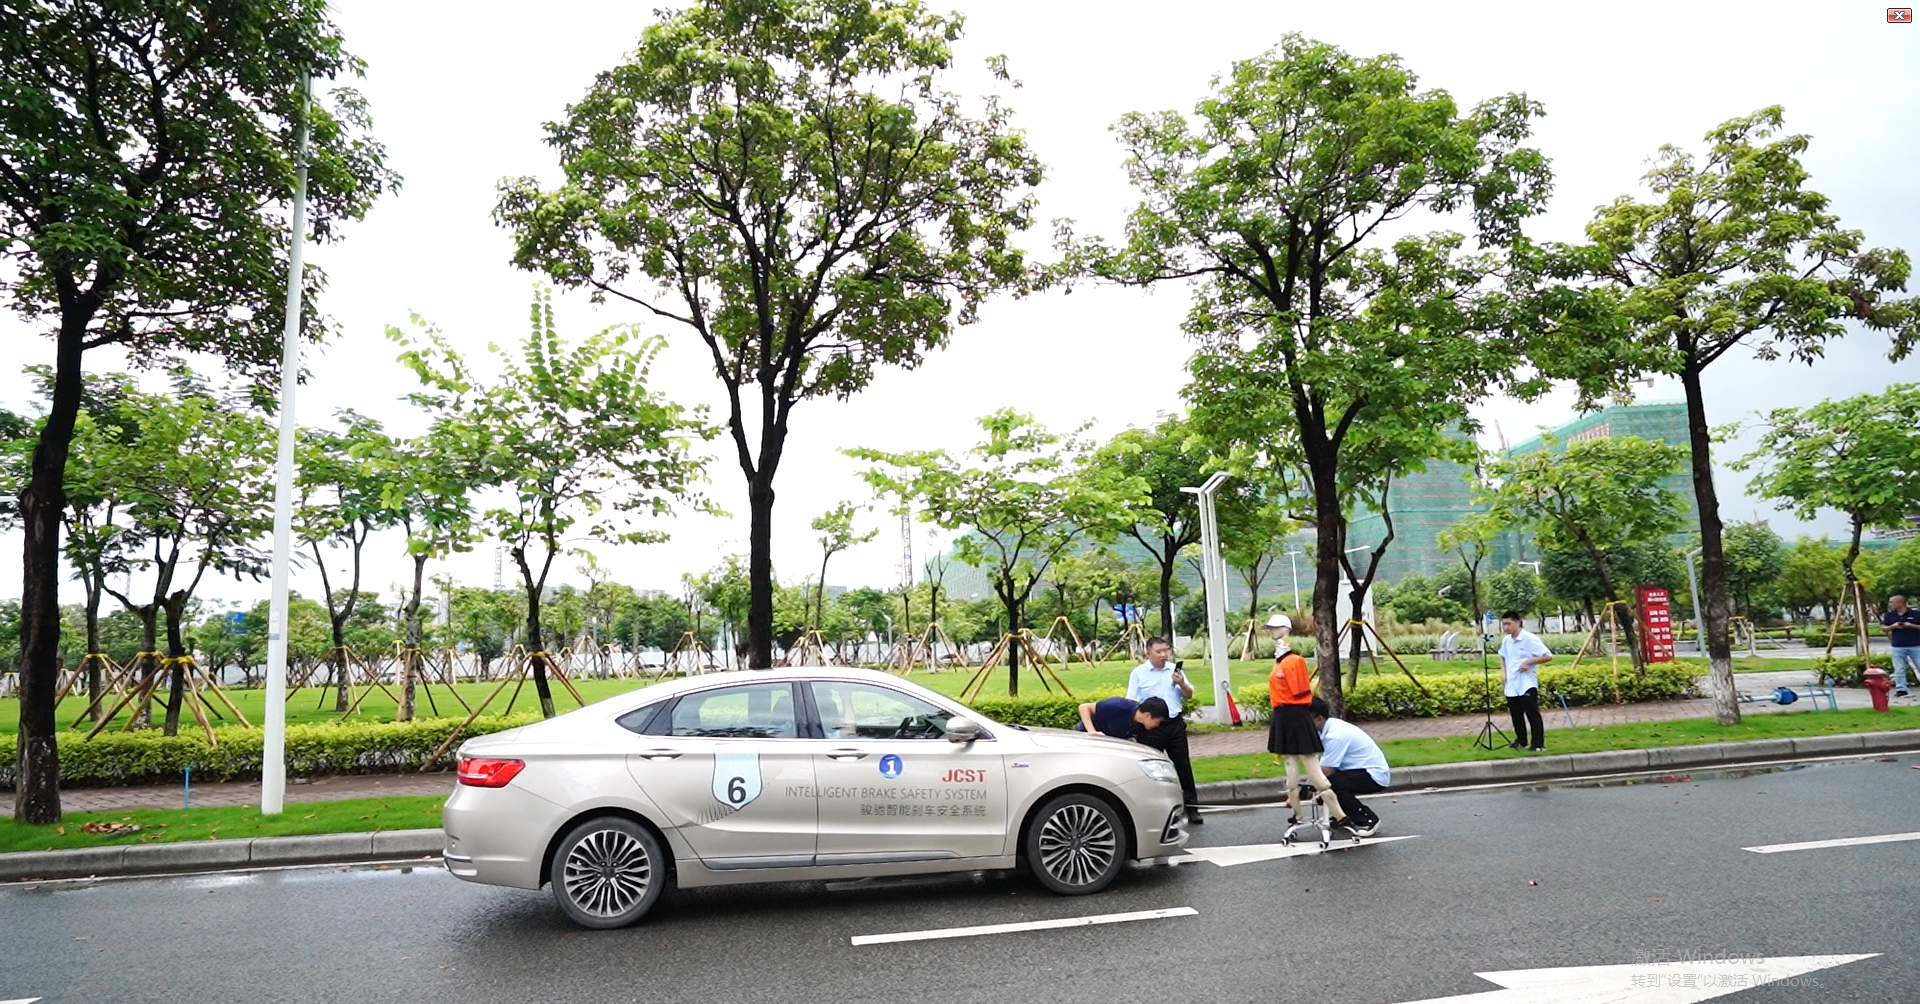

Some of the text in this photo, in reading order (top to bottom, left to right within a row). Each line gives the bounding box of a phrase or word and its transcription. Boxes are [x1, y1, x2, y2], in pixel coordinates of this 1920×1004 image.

[886, 760, 897, 775] 1
[942, 769, 986, 783] JCST
[728, 776, 746, 804] 6
[785, 786, 987, 800] INTELLIGENT BRAKE SAFETY SYSTEM
[860, 804, 986, 817] 骏驰智能刹车安全系统
